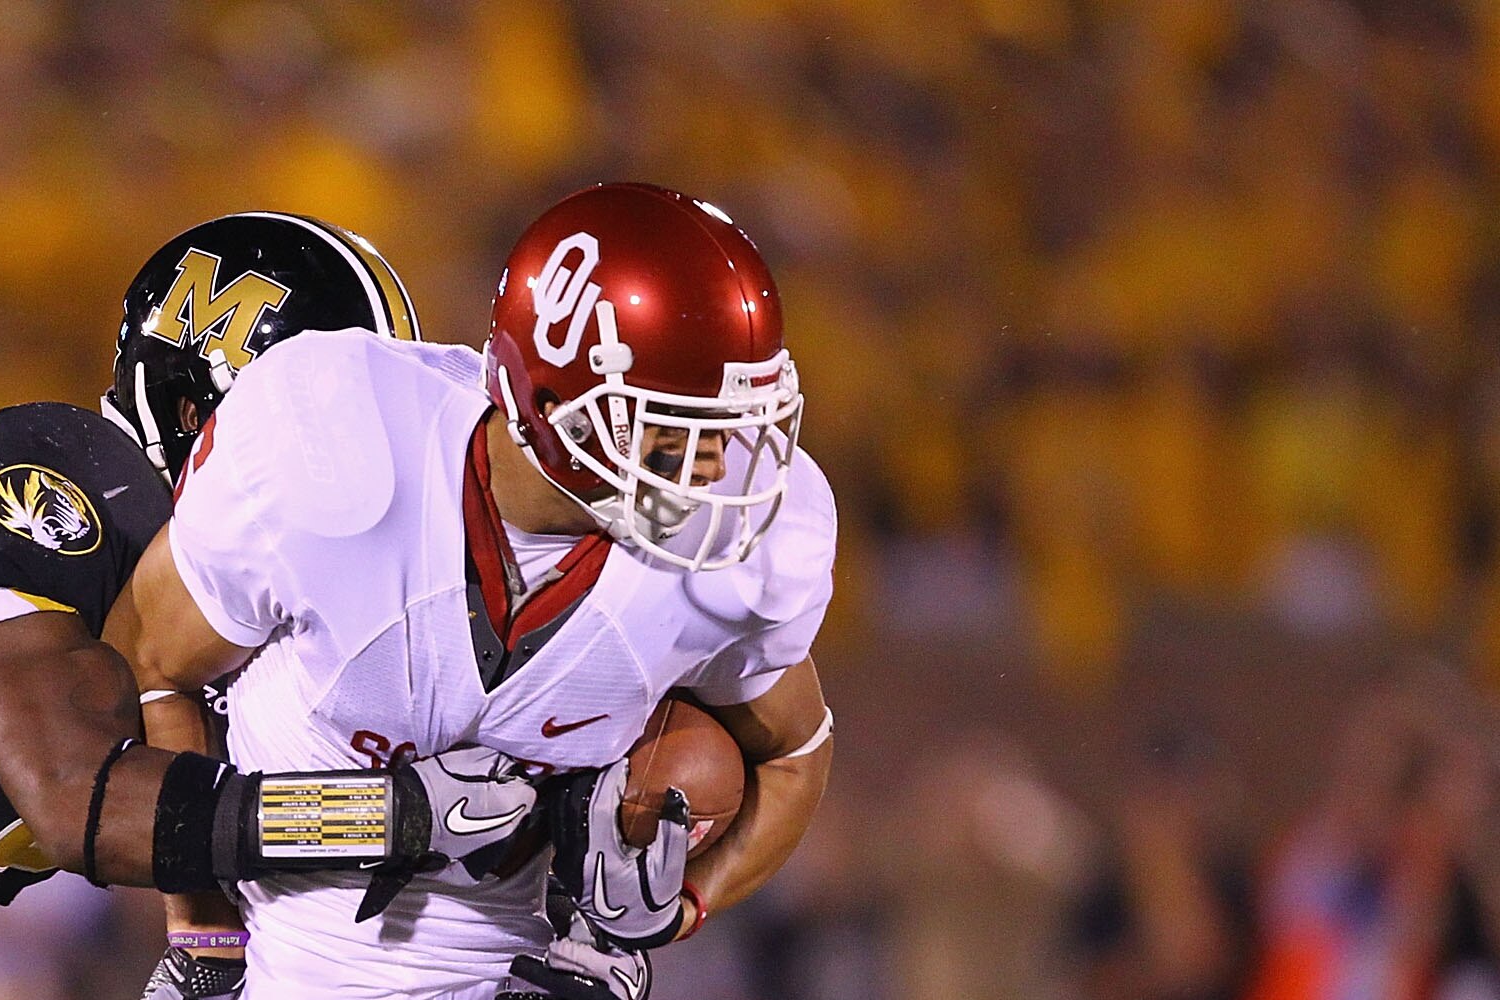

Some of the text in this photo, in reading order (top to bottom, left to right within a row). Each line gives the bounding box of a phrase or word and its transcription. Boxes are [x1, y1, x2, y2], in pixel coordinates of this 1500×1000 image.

[142, 247, 292, 372] M
[533, 231, 602, 368] OU
[614, 424, 630, 459] Ridd
